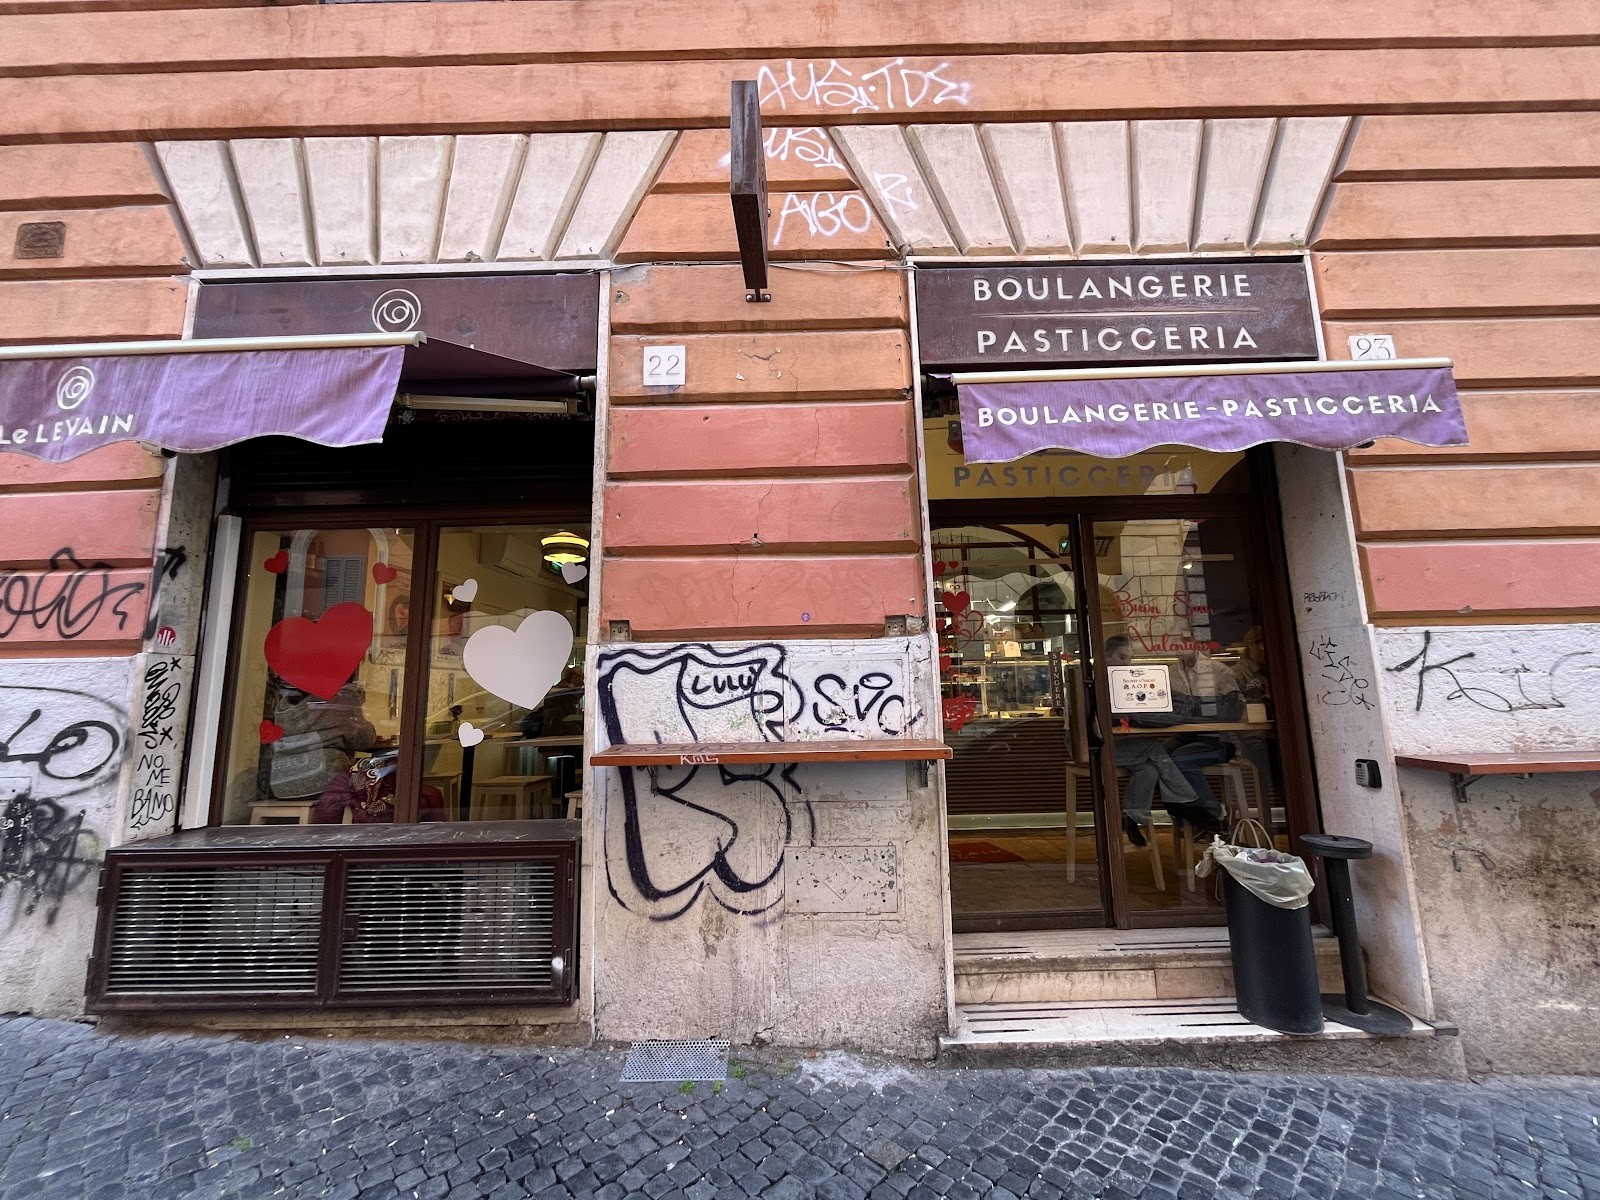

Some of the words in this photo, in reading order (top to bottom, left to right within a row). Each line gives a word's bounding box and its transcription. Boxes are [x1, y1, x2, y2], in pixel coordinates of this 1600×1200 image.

[973, 274, 1252, 301] BOULANGERIE
[977, 326, 1258, 354] PASTICCERIA
[649, 354, 680, 376] 22
[0, 424, 28, 445] Le
[36, 413, 134, 444] LEVAIN
[1052, 652, 1062, 707] SPINGERE
[137, 753, 164, 772] NO
[146, 768, 171, 786] ME
